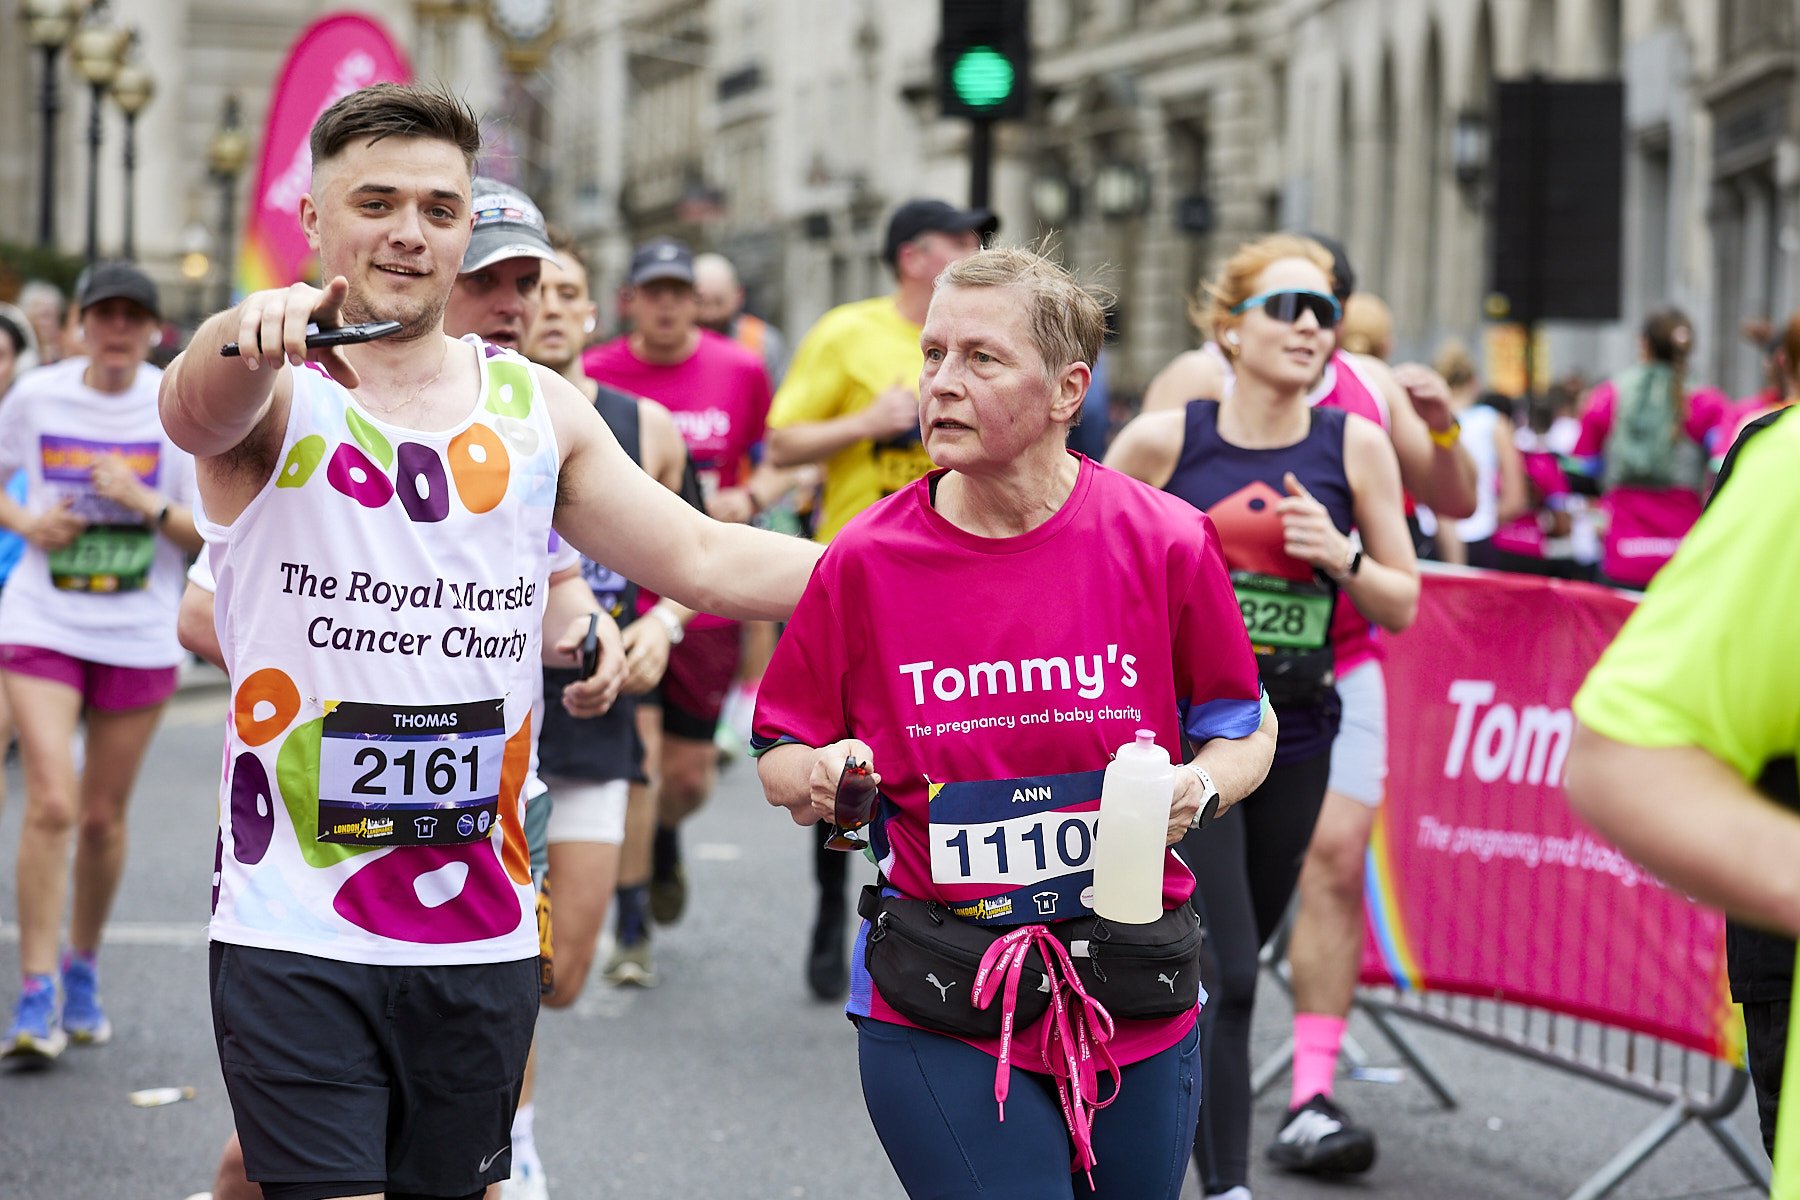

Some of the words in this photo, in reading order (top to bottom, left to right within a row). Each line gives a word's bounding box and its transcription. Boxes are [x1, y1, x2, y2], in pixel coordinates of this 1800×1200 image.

[280, 562, 338, 599] The
[345, 571, 444, 612] Royal
[449, 576, 536, 612] Marsde
[307, 616, 431, 656] Cancer
[898, 643, 1139, 706] Tommy's
[392, 712, 458, 729] THOMAS
[906, 724, 932, 739] The
[936, 714, 1016, 736] pregnancy
[1020, 709, 1050, 725] and
[1053, 707, 1094, 723] baby
[1097, 704, 1142, 722] charity
[1443, 678, 1573, 789] Tom
[351, 745, 480, 796] 2161
[1011, 786, 1052, 803] ANN
[333, 823, 360, 834] LONDON
[945, 817, 1100, 878] 1110
[953, 905, 978, 917] LONDON
[977, 968, 989, 986] Team
[996, 955, 1010, 971] Team
[1004, 1012, 1013, 1032] Team
[1059, 1086, 1067, 1106] Team
[1063, 1105, 1076, 1136] Tommy's
